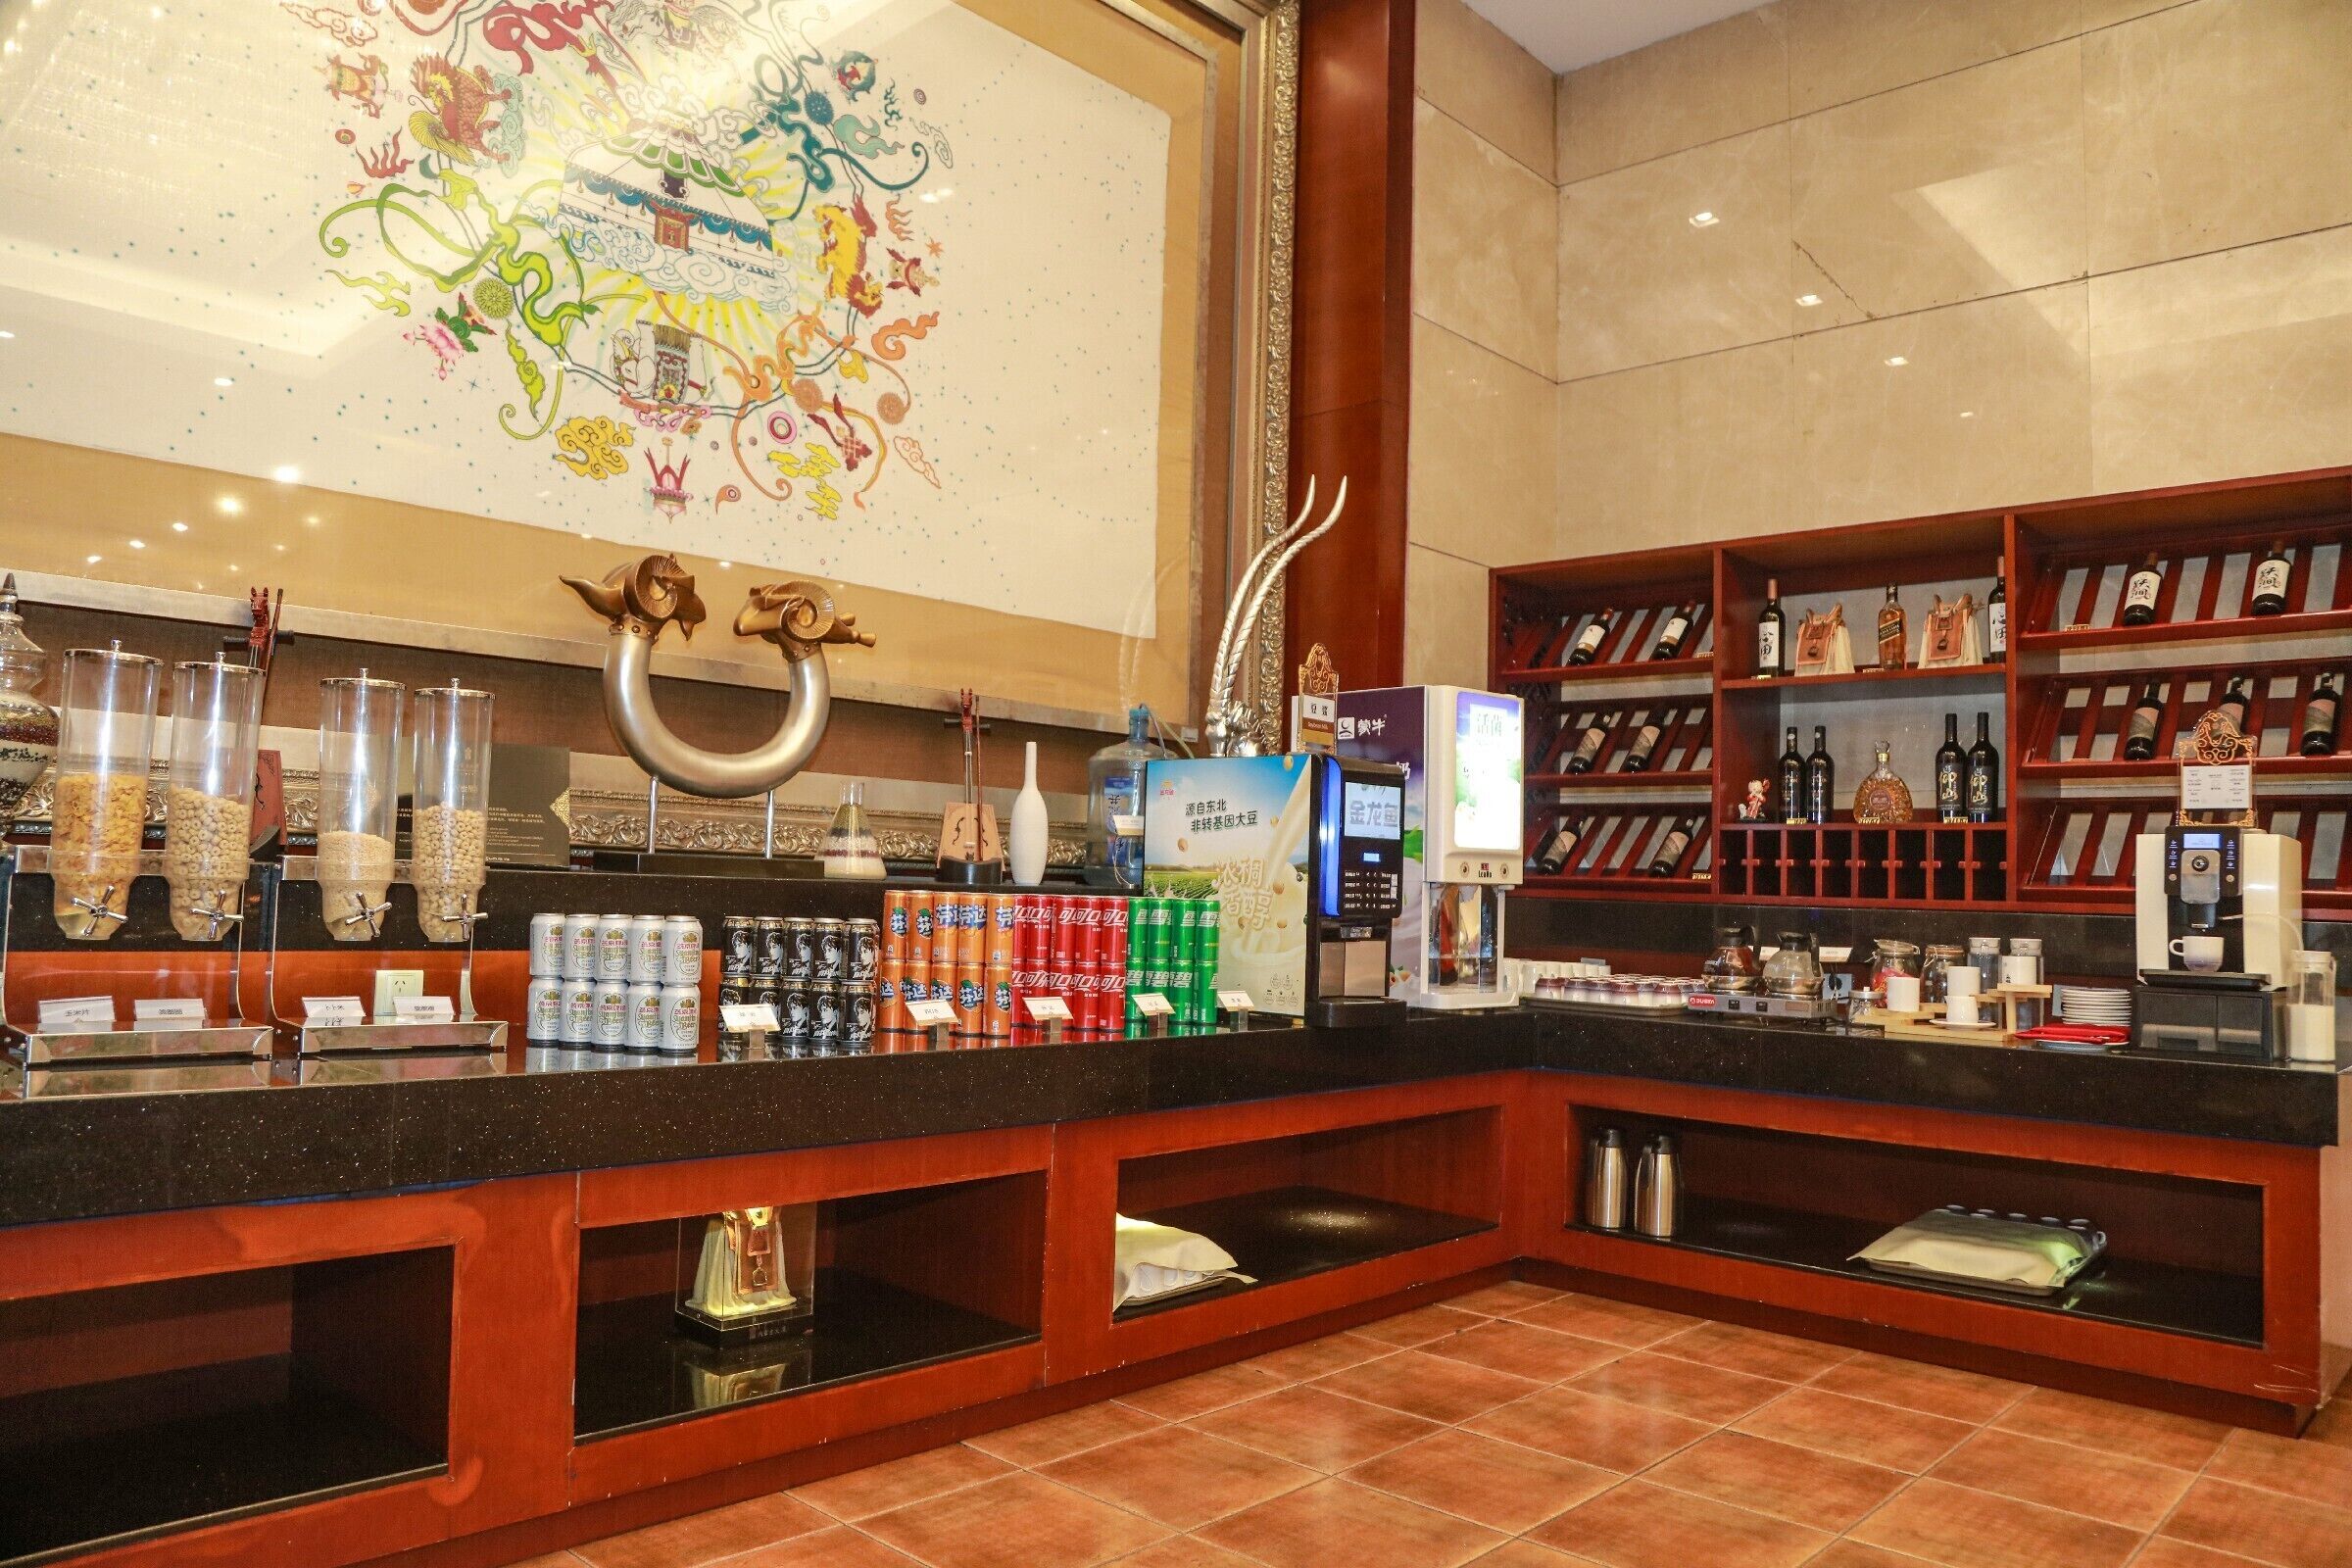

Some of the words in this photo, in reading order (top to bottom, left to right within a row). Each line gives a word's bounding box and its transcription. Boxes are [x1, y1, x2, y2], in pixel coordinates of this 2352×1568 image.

[1357, 718, 1386, 737] 蒙牛
[1185, 799, 1227, 816] 源自东北
[1349, 800, 1398, 828] 金龙鱼
[1191, 810, 1259, 833] 非转基因大豆
[1212, 857, 1265, 889] 浓稠
[959, 905, 987, 925] 芬达
[1222, 887, 1274, 931] 香醇
